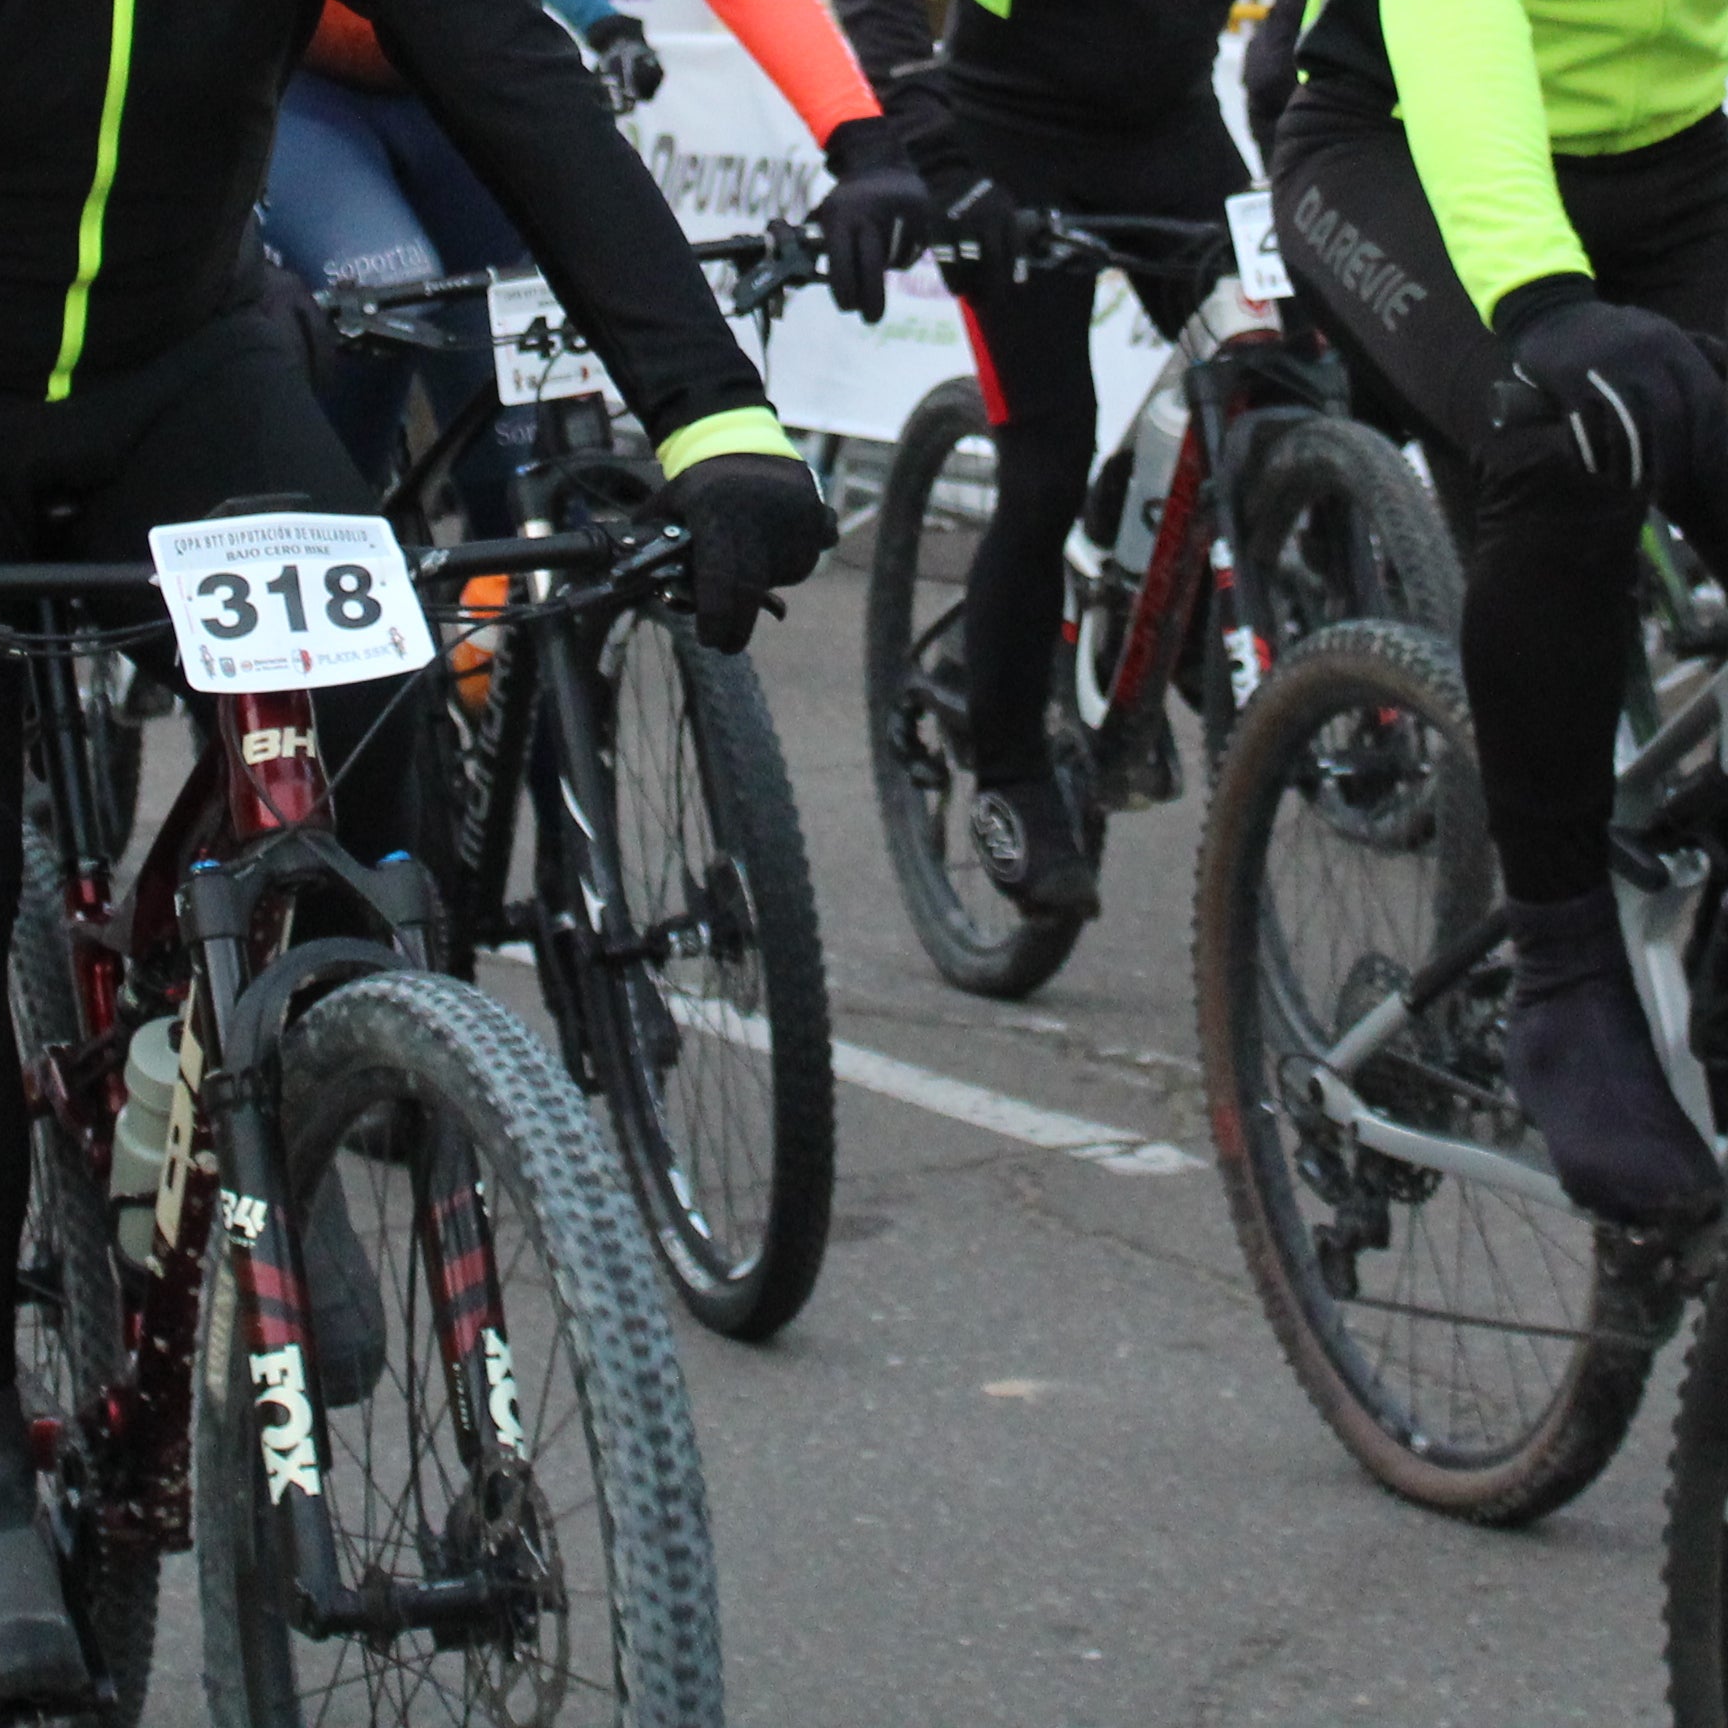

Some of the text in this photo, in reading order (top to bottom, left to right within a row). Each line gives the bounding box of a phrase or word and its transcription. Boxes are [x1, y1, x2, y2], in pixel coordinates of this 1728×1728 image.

[174, 536, 202, 554] COPA
[206, 534, 226, 549] BTT
[228, 525, 292, 547] DIPUTACIÓN
[294, 526, 308, 541] DE
[226, 546, 261, 562] BAJO
[264, 545, 302, 557] CERO
[196, 563, 383, 641] 318
[242, 727, 317, 766] BH
[249, 1342, 321, 1505] FOX
